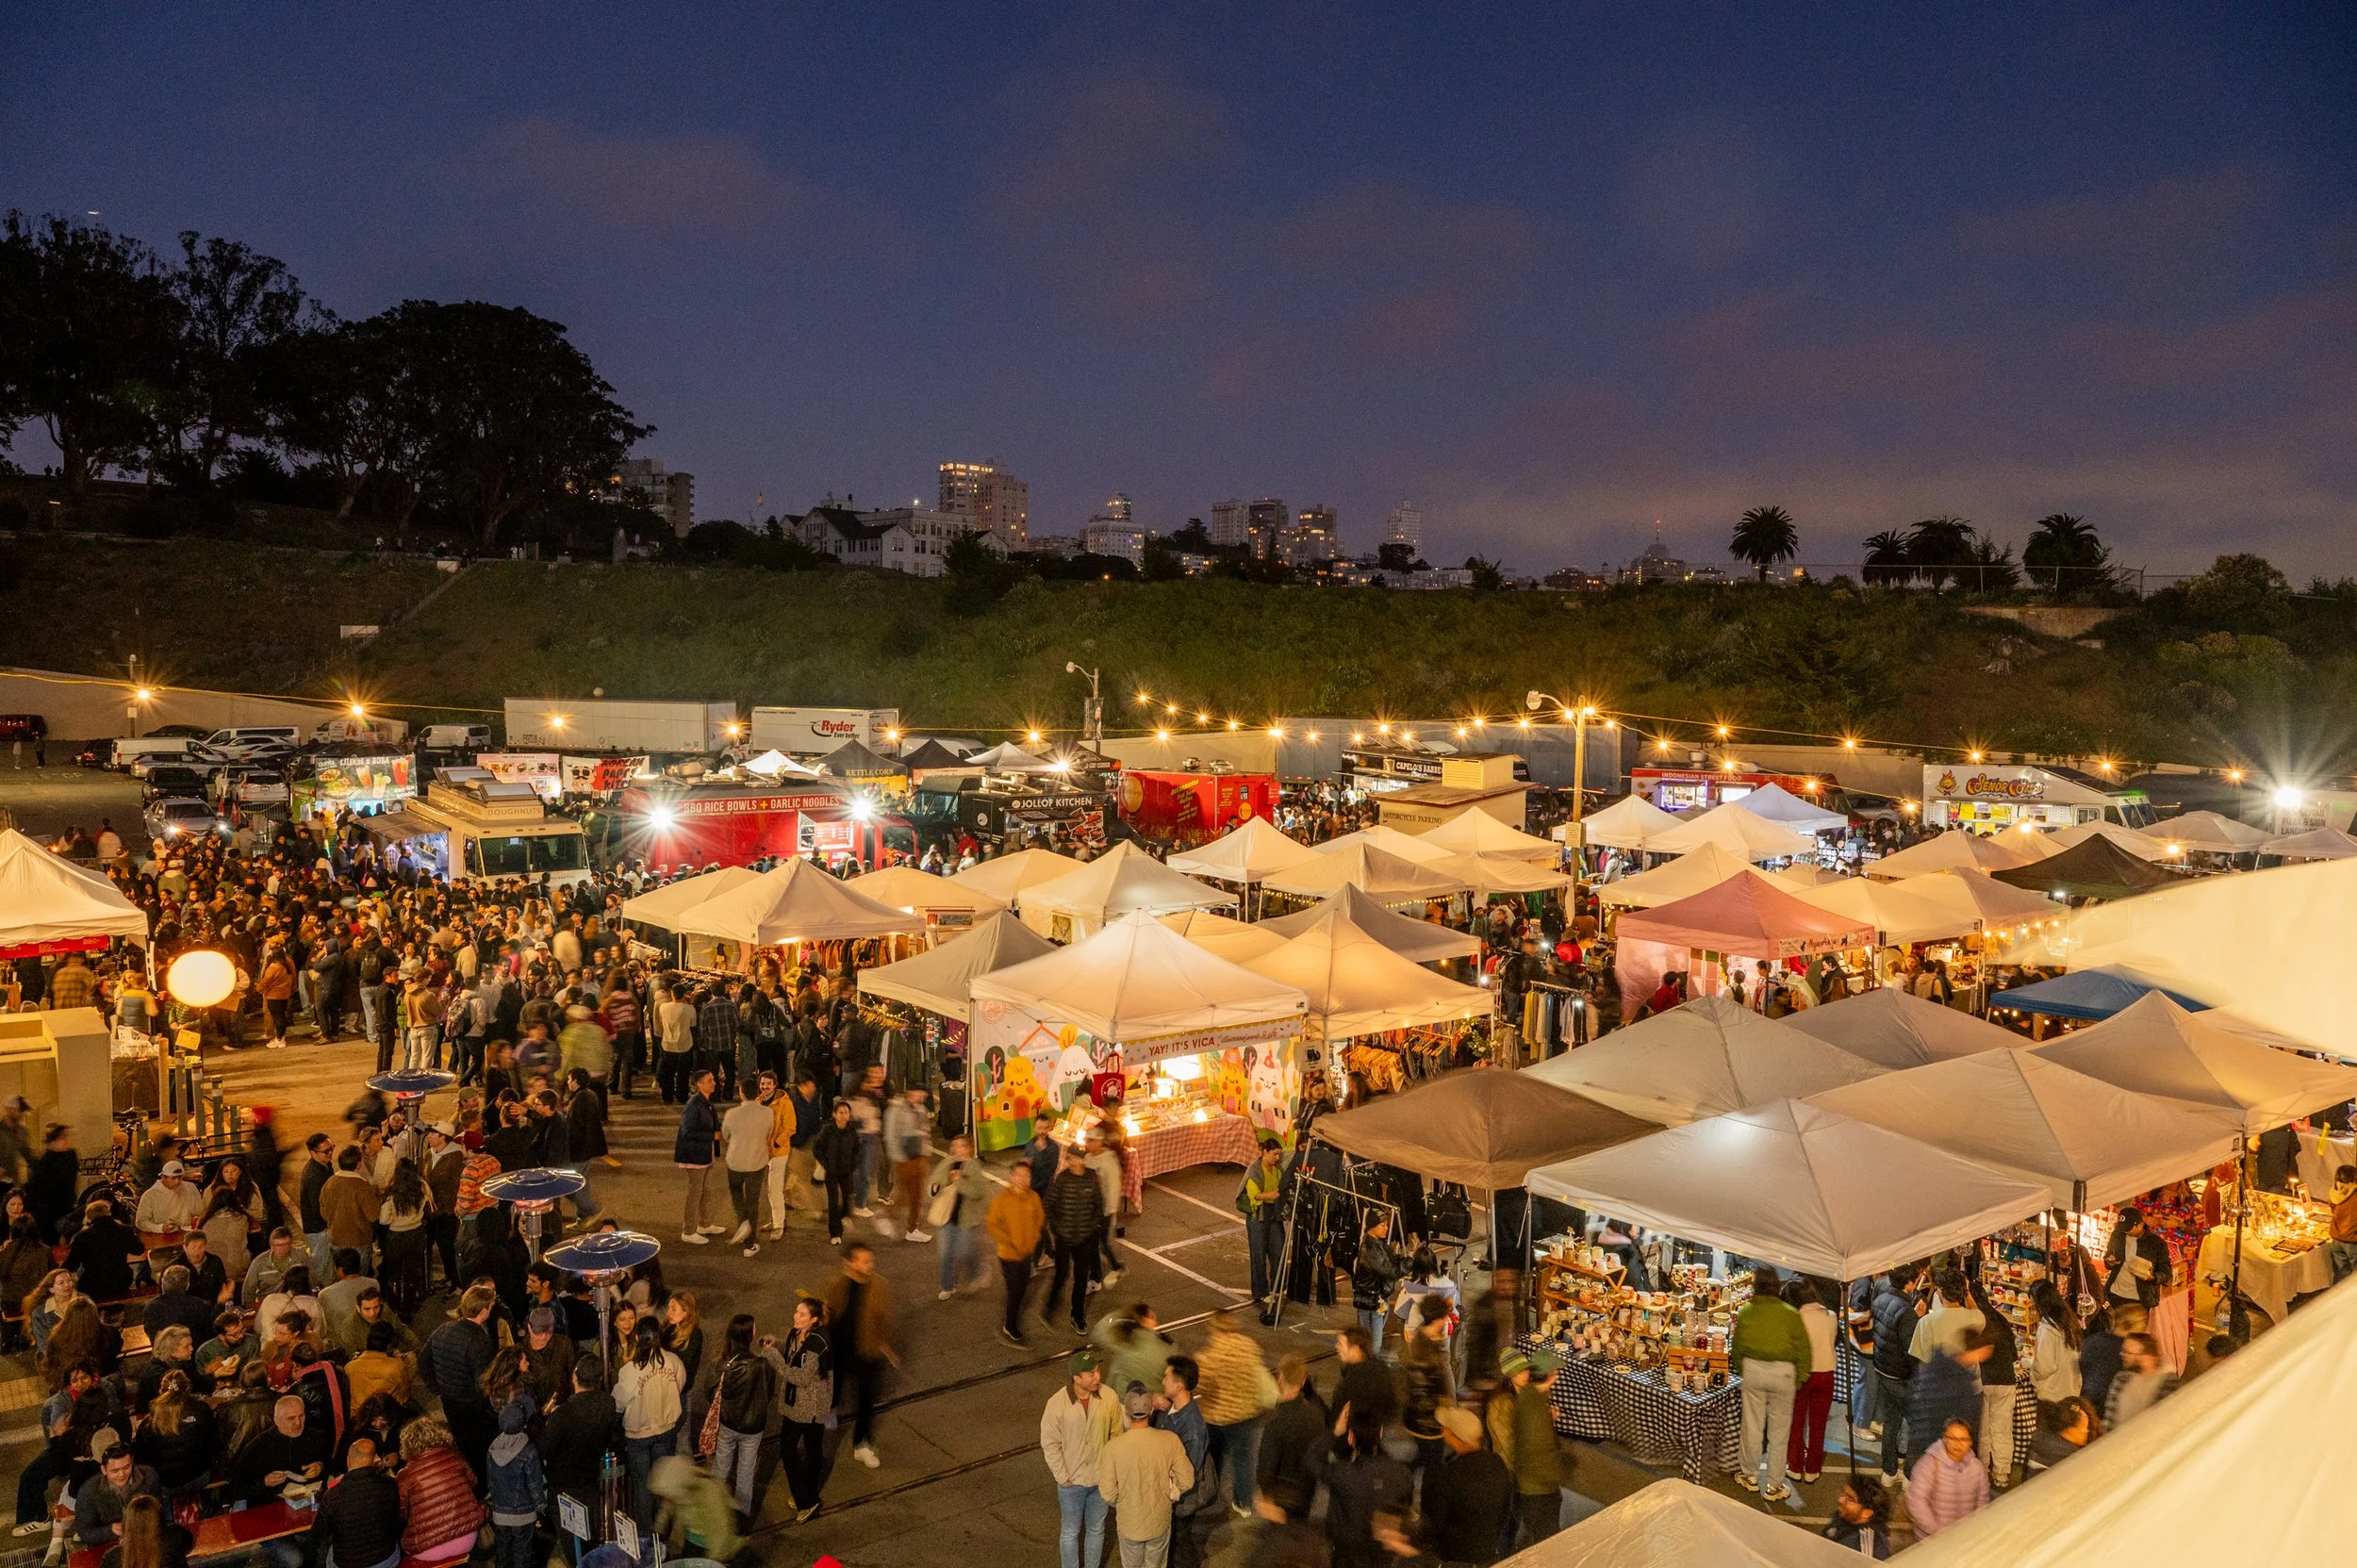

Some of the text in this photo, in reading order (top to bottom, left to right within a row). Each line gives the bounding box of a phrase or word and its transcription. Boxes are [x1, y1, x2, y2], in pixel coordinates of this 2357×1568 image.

[821, 719, 856, 734] Ryder
[371, 756, 390, 765] BOBA
[602, 757, 645, 767] KOREAN
[1396, 761, 1442, 774] CAPELO'S BARBE
[604, 779, 632, 790] KITC
[684, 802, 702, 813] BBQ
[704, 801, 725, 812] RICE
[727, 800, 757, 811] BOWLS
[770, 799, 801, 809] GARLIC
[802, 797, 841, 807] NOODLES
[1021, 797, 1093, 808] JOLLOF KITCHEN
[487, 807, 541, 816] DOUGHNUTS
[1382, 811, 1442, 824] MOTORCYCLE PARKING
[2309, 818, 2326, 827] SIGN
[2281, 827, 2318, 835] LANGUA
[1148, 1043, 1169, 1057] YAY!
[1172, 1040, 1189, 1052] IT'S
[1192, 1037, 1215, 1049] VICA
